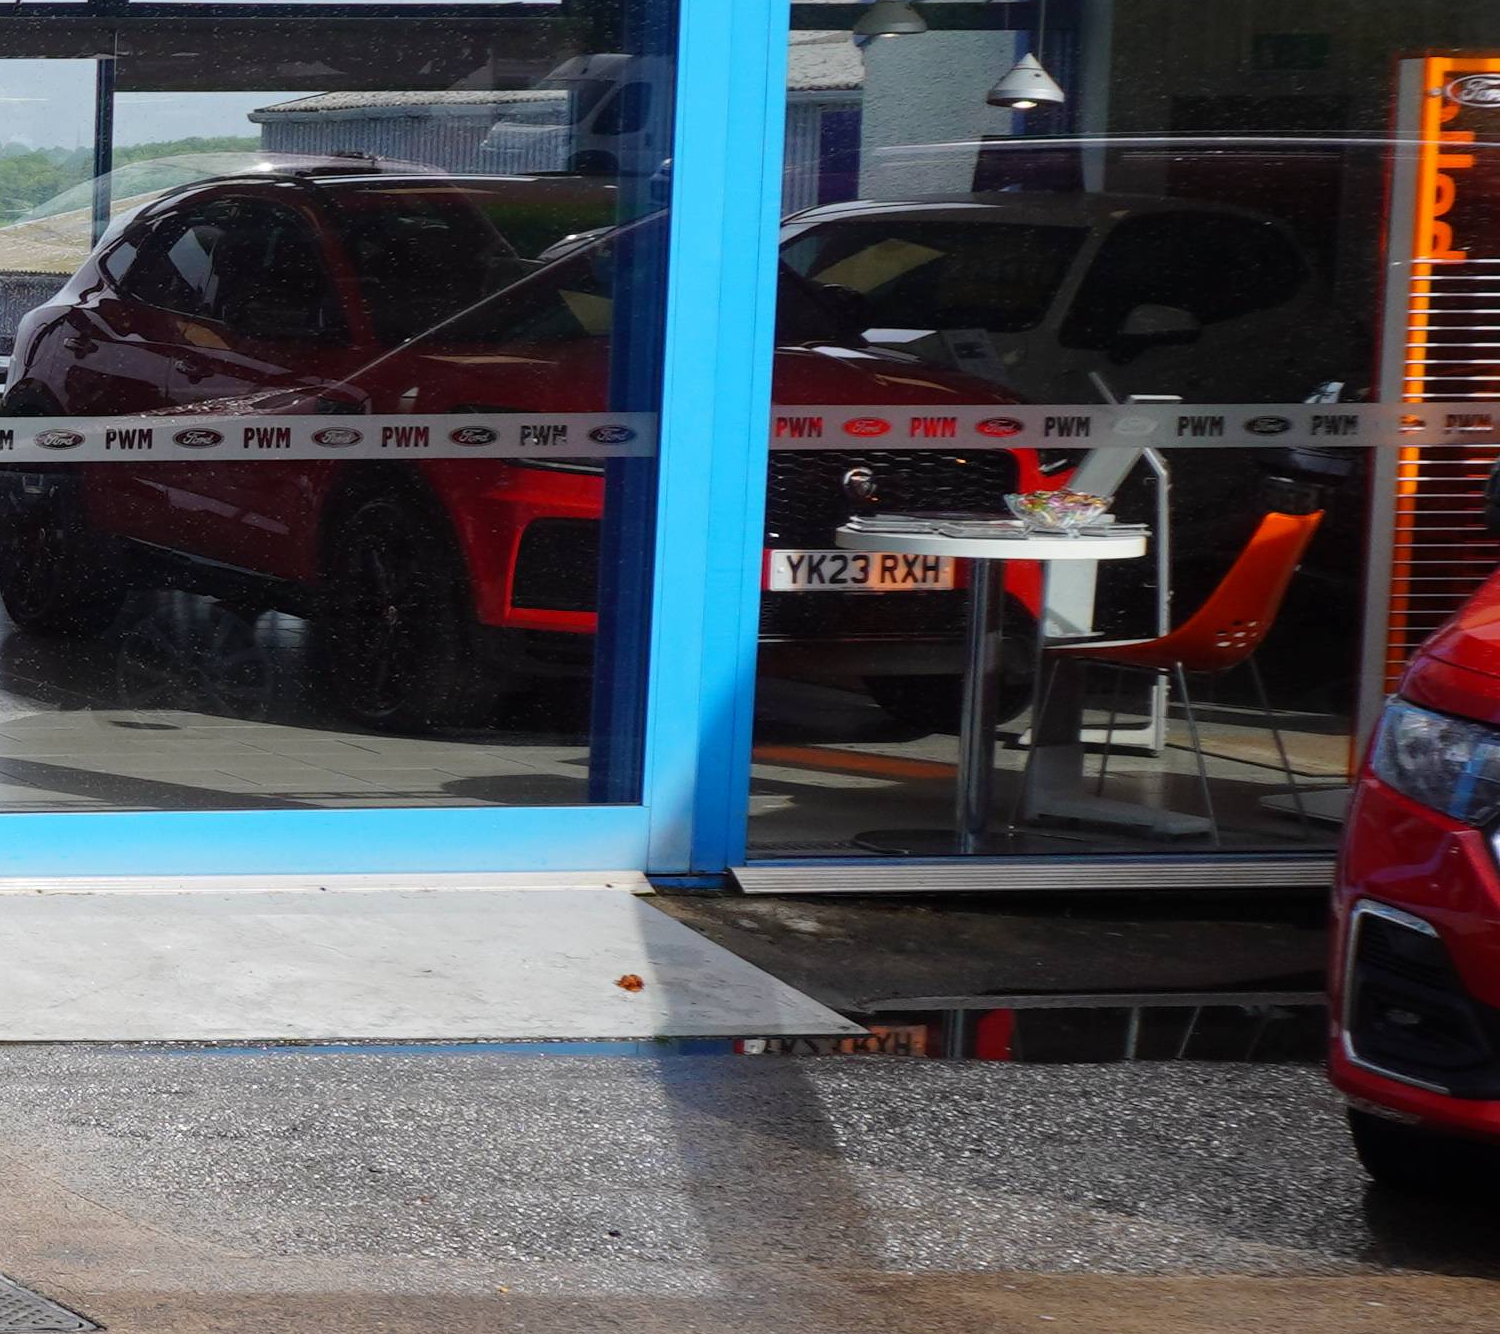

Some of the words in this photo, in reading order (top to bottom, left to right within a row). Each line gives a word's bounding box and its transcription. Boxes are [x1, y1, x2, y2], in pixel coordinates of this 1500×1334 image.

[105, 428, 153, 450] PWM
[243, 427, 291, 449] PWM
[381, 426, 430, 448] PWM
[775, 417, 823, 438] PWM
[910, 417, 957, 438] PWM
[1044, 416, 1091, 437] PWM
[1177, 416, 1224, 437] PWM
[787, 554, 870, 585] YK23
[879, 553, 941, 584] RXH
